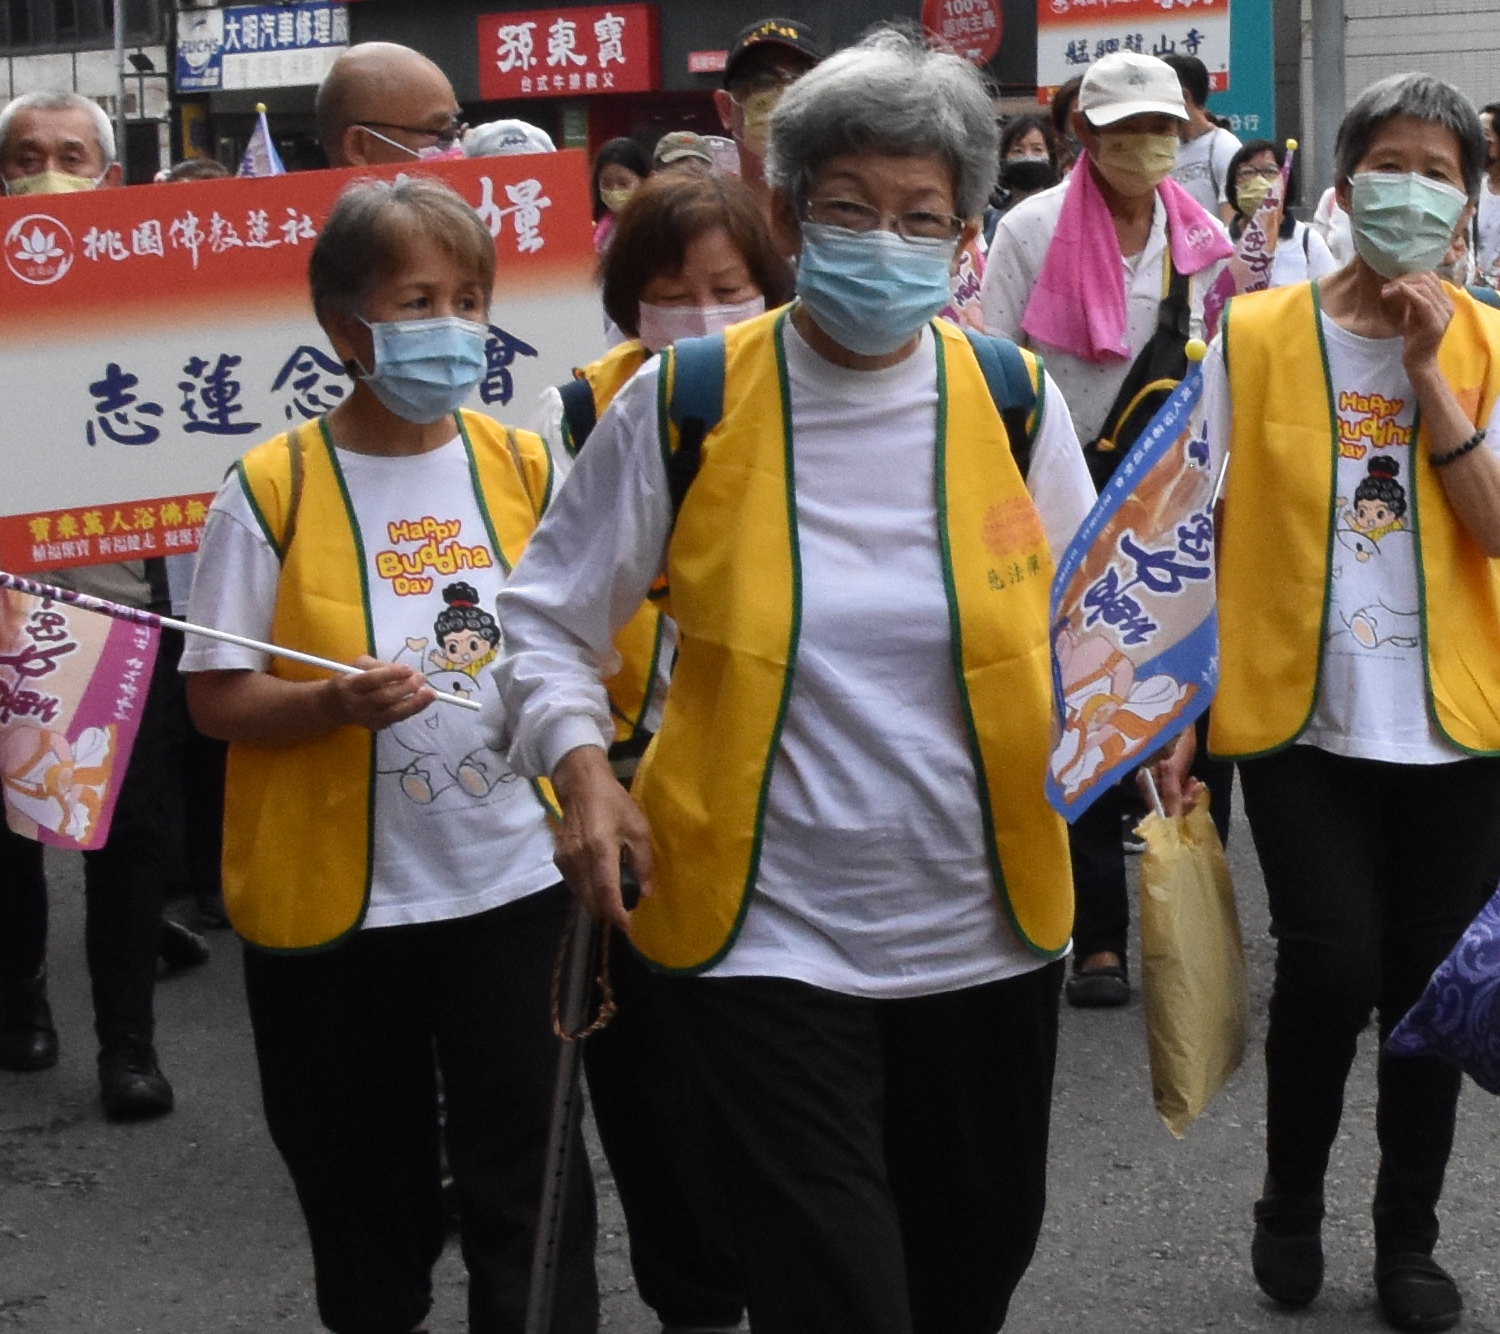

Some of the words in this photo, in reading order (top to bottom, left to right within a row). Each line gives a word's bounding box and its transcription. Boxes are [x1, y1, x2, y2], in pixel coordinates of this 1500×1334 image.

[224, 8, 348, 51] 大明汽車修理廠
[496, 11, 627, 74] 孫東寶
[519, 71, 616, 92] 台式牛排教父
[81, 207, 317, 270] 桃園佛教蓮社
[85, 322, 540, 448] 志蓮念會
[1339, 390, 1406, 418] Happy
[387, 516, 462, 545] Happy
[375, 539, 492, 580] Buddha
[393, 575, 434, 597] Day
